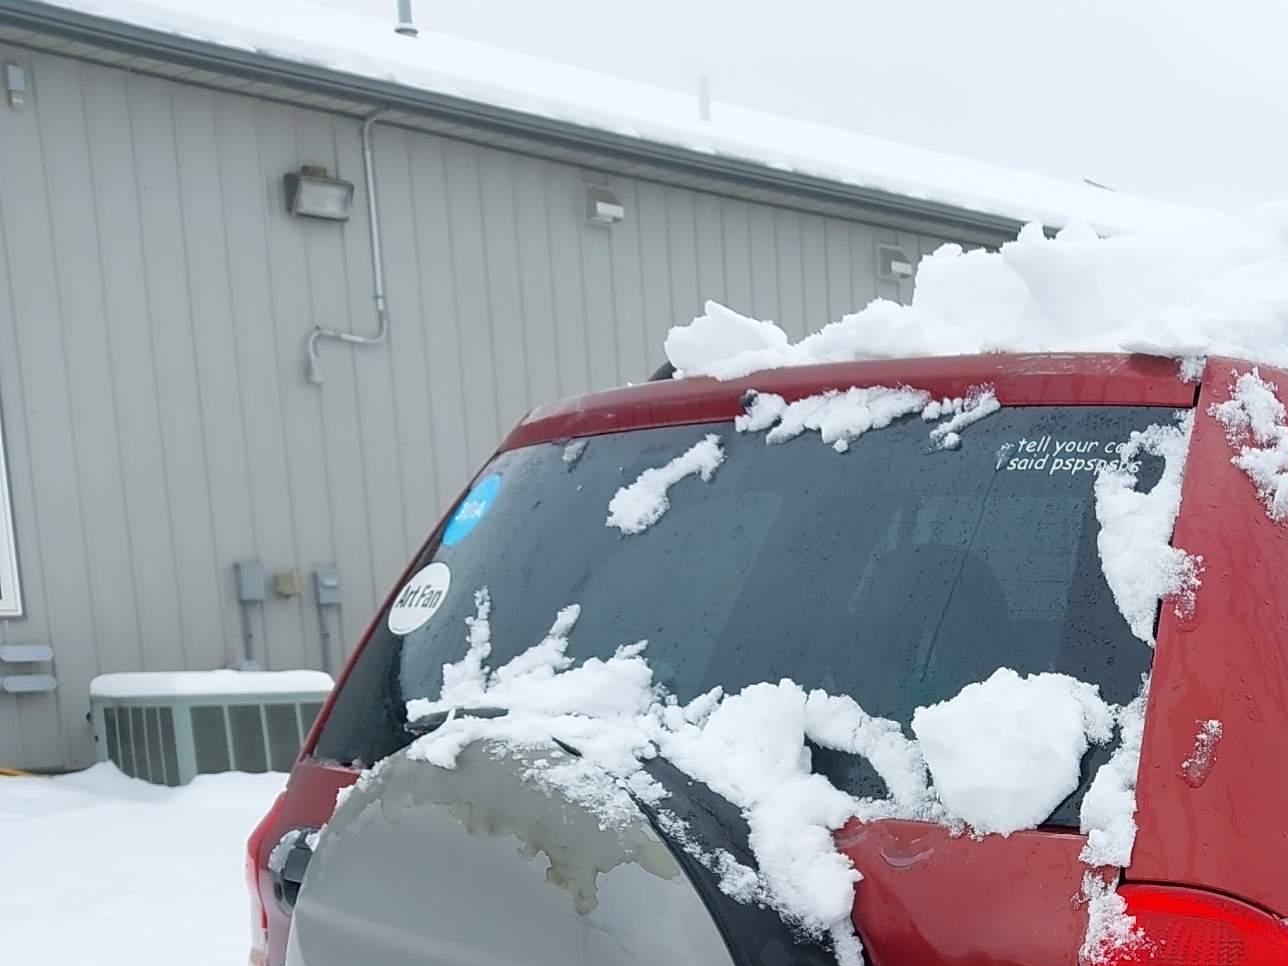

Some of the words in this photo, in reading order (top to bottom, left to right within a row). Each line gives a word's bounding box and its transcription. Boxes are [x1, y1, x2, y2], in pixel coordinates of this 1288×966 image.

[1017, 435, 1052, 453] tell
[1052, 440, 1099, 457] your
[1006, 453, 1050, 471] said
[395, 584, 421, 608] Art
[414, 584, 443, 608] Fan
